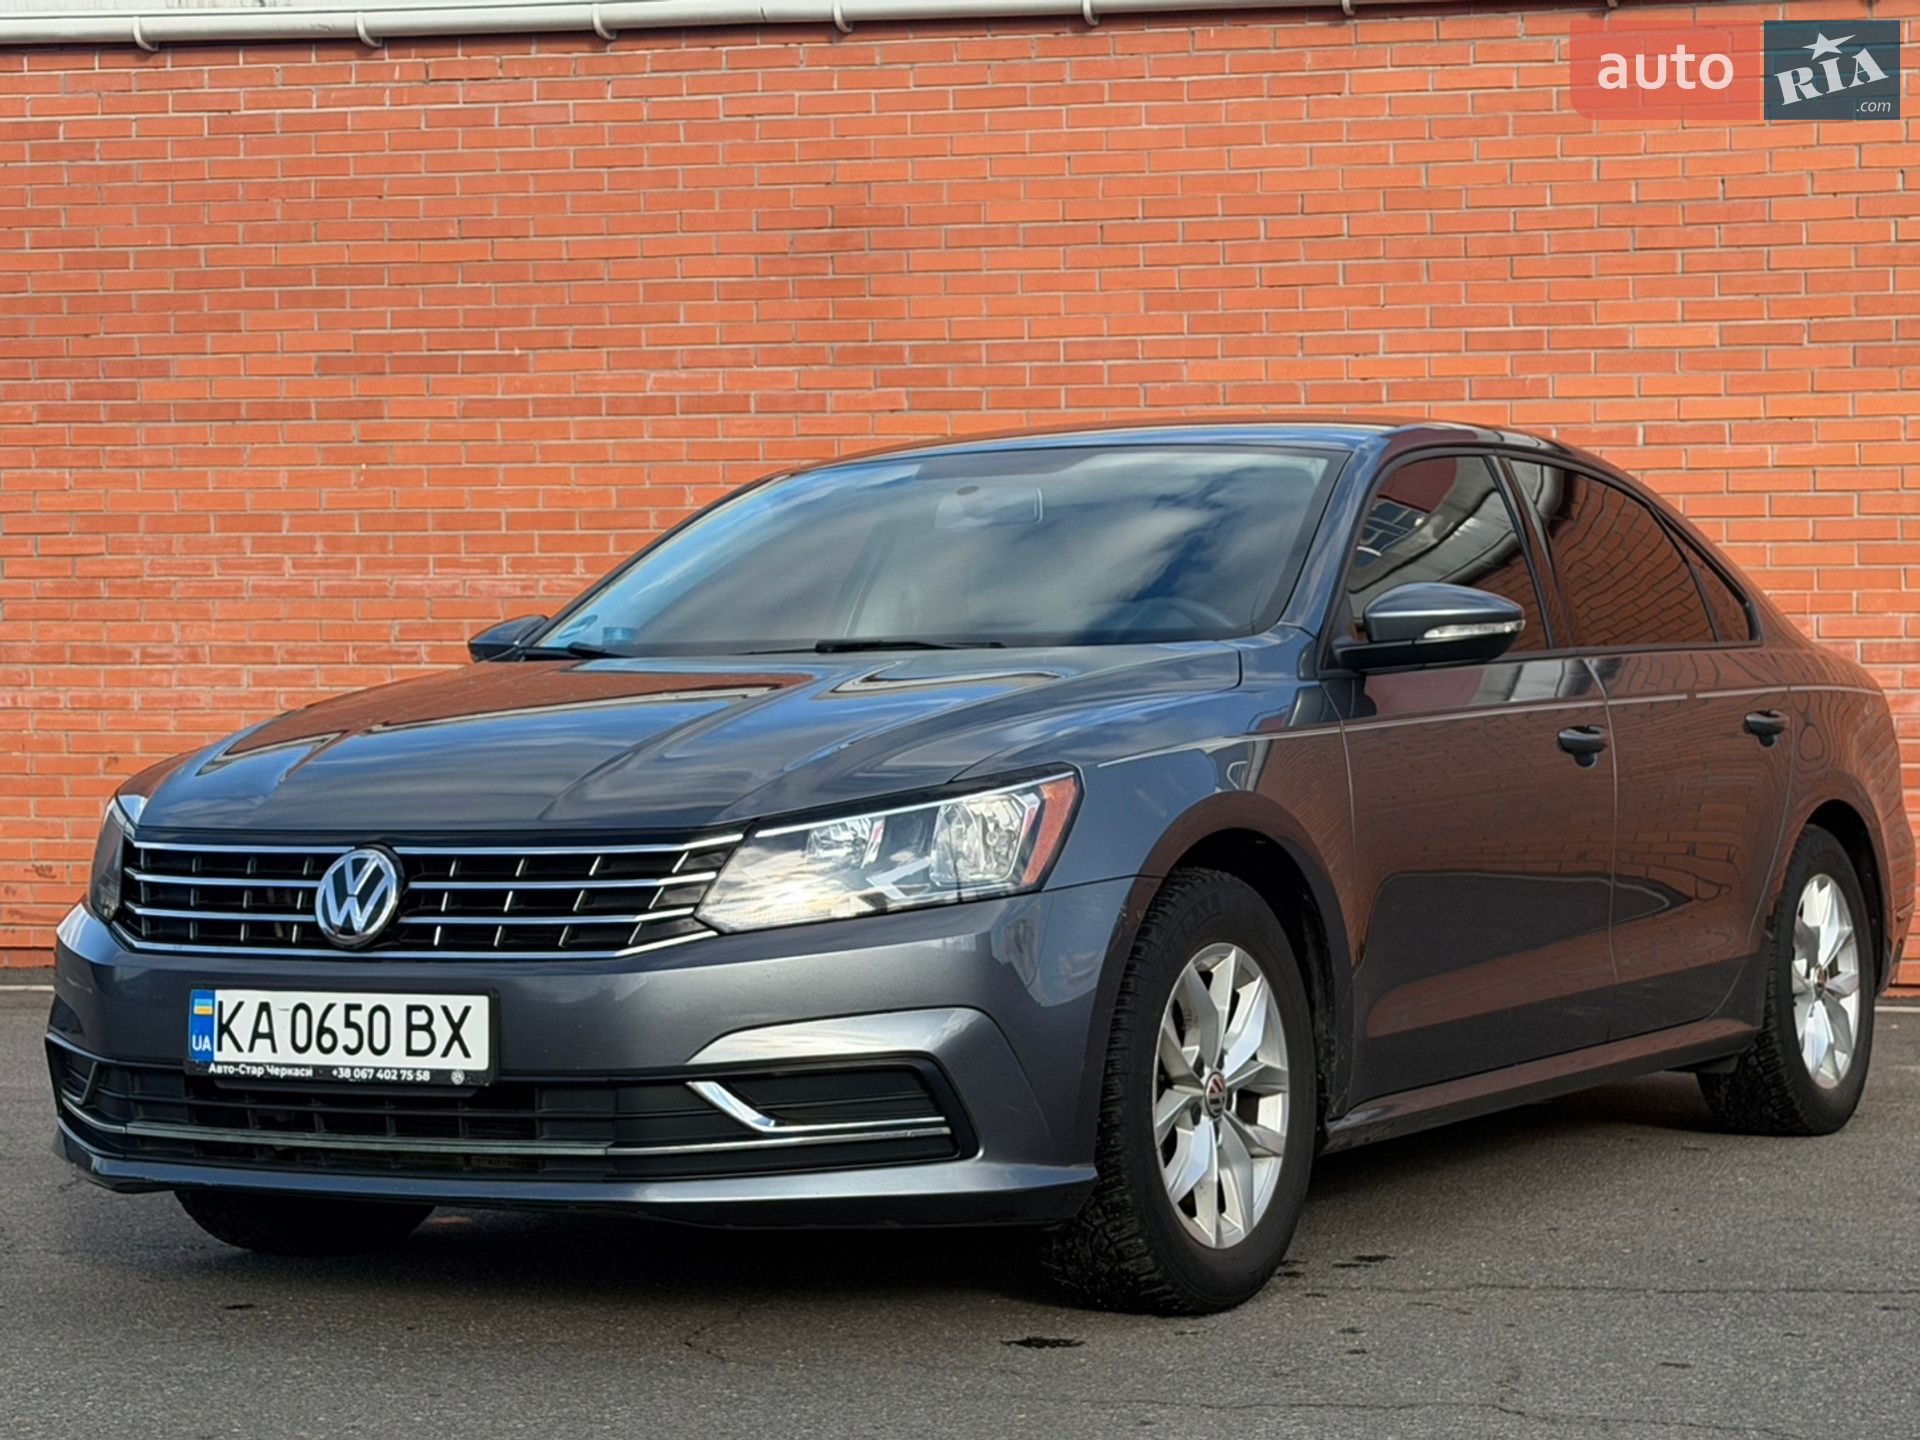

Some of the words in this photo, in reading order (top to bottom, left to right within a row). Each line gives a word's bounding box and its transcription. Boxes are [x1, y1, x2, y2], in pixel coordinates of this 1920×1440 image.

[216, 1000, 278, 1054] KA
[290, 1002, 392, 1057] 0650
[405, 1004, 473, 1059] BX
[192, 1034, 212, 1052] UA
[353, 1068, 375, 1080] 067
[376, 1069, 398, 1081] 402
[400, 1070, 415, 1081] 75
[416, 1070, 431, 1082] 58
